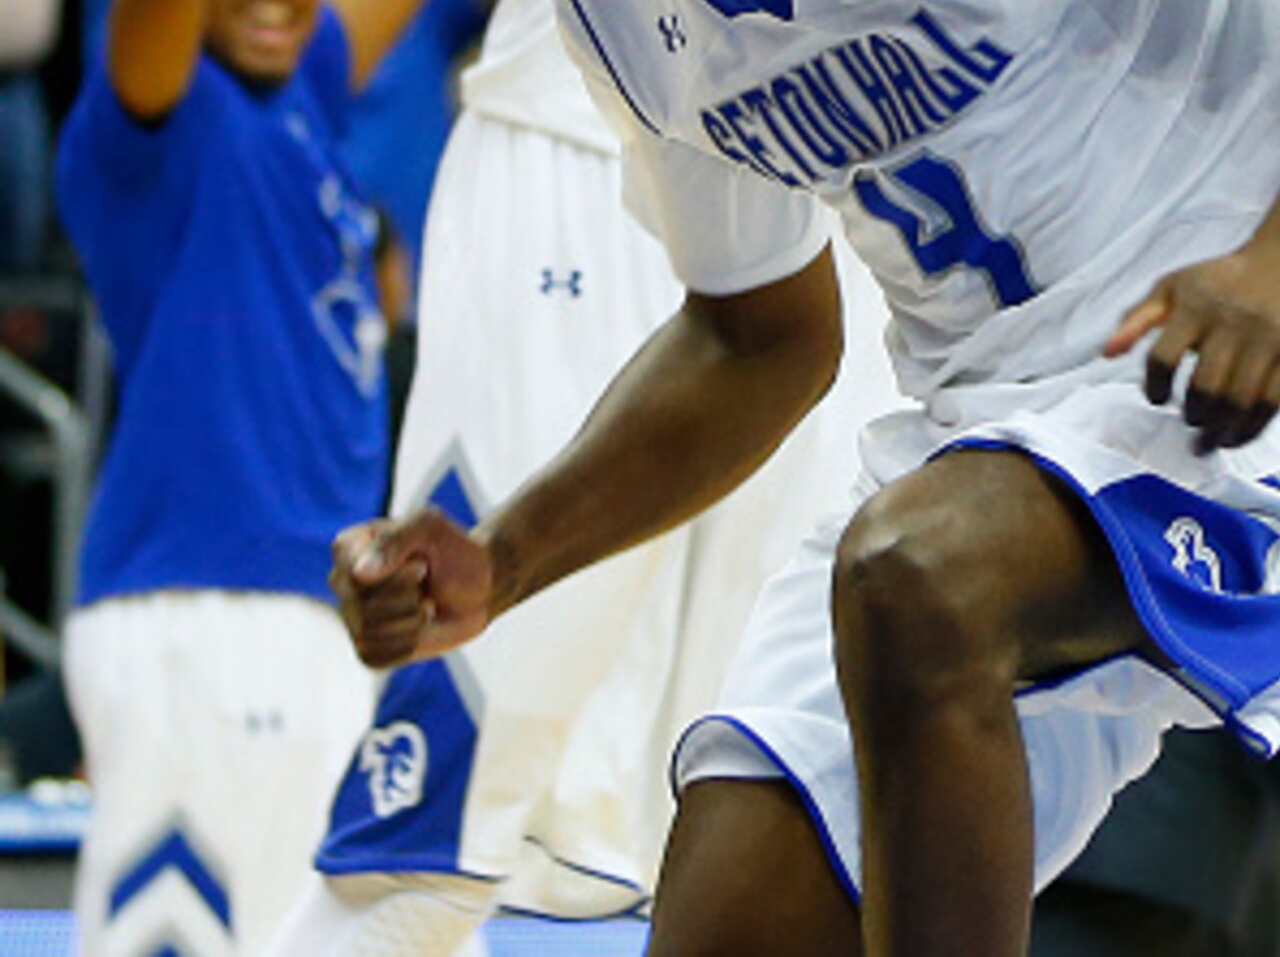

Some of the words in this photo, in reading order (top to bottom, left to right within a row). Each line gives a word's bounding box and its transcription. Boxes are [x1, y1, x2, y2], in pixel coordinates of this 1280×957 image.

[700, 53, 886, 189] SETON
[828, 6, 1015, 151] HALL
[850, 148, 1040, 308] 4
